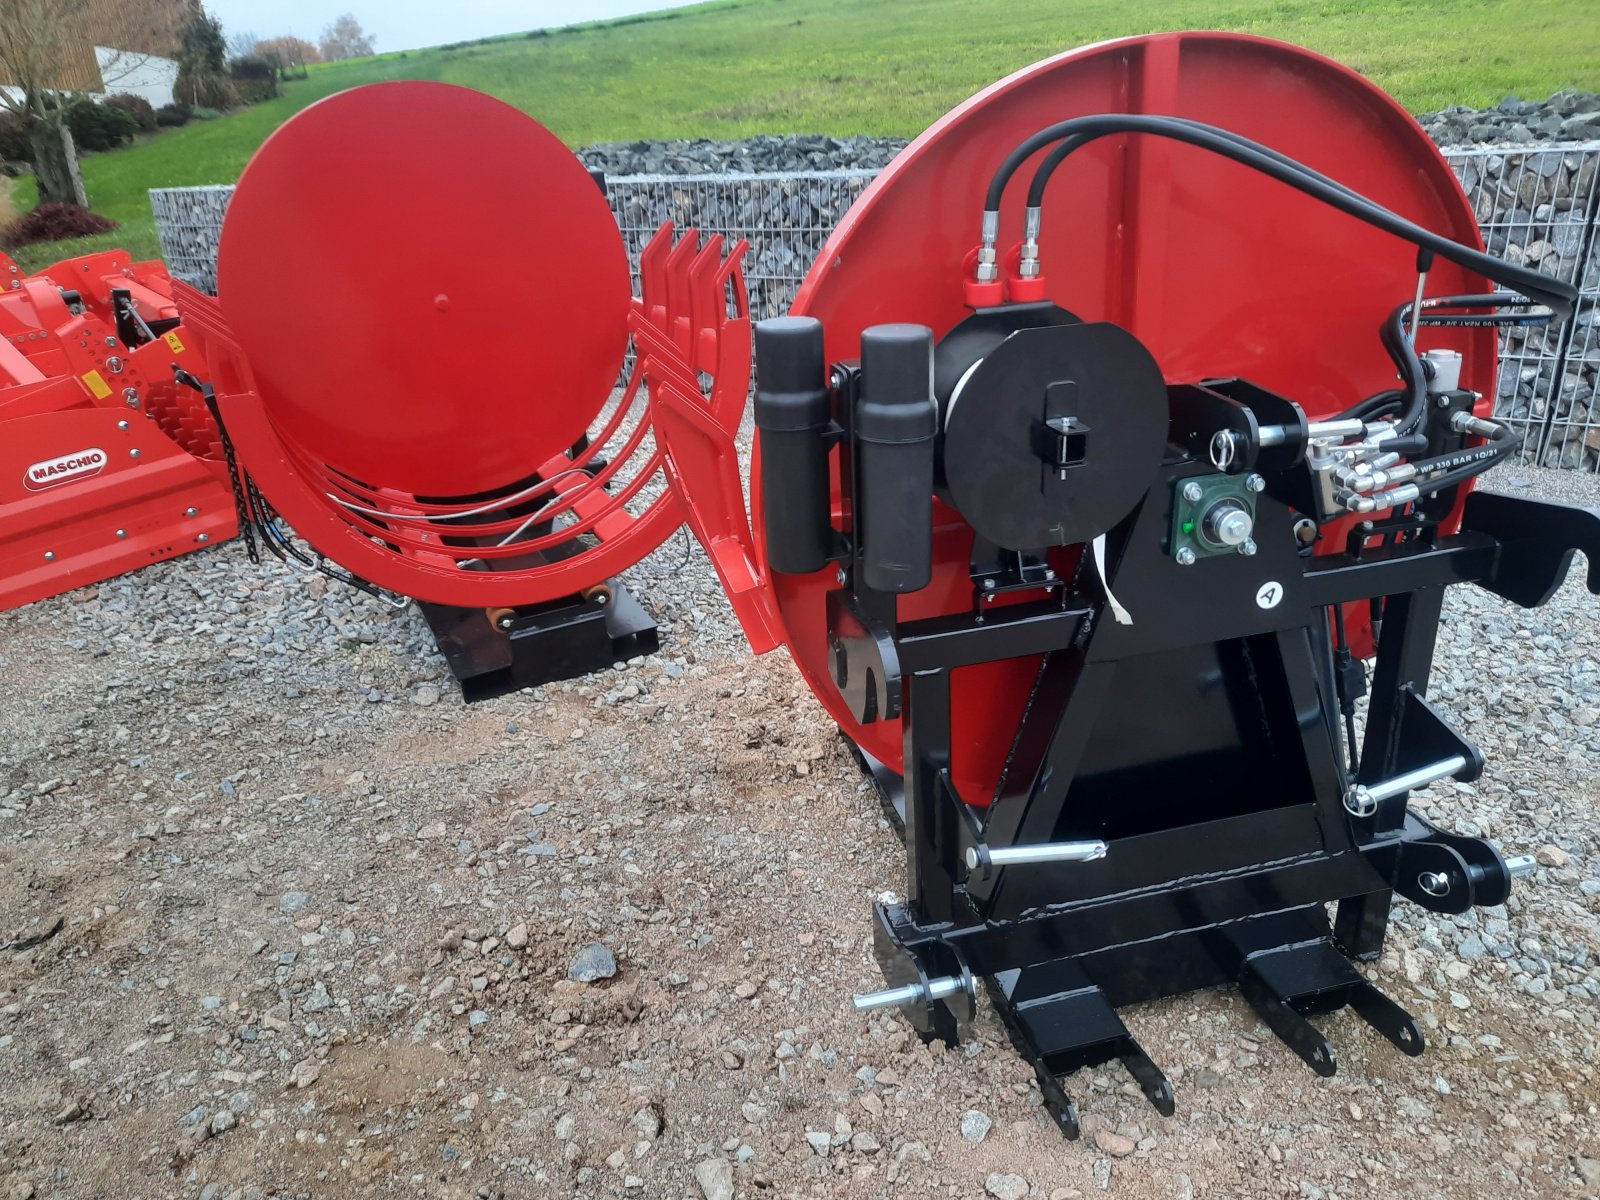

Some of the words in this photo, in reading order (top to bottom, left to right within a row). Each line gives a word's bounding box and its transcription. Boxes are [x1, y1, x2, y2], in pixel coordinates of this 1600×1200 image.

[33, 453, 102, 479] MASCHIO
[1420, 464, 1434, 474] WP
[1453, 455, 1472, 465] BAR
[1475, 448, 1497, 460] 1Q/21
[1260, 587, 1275, 604] A
